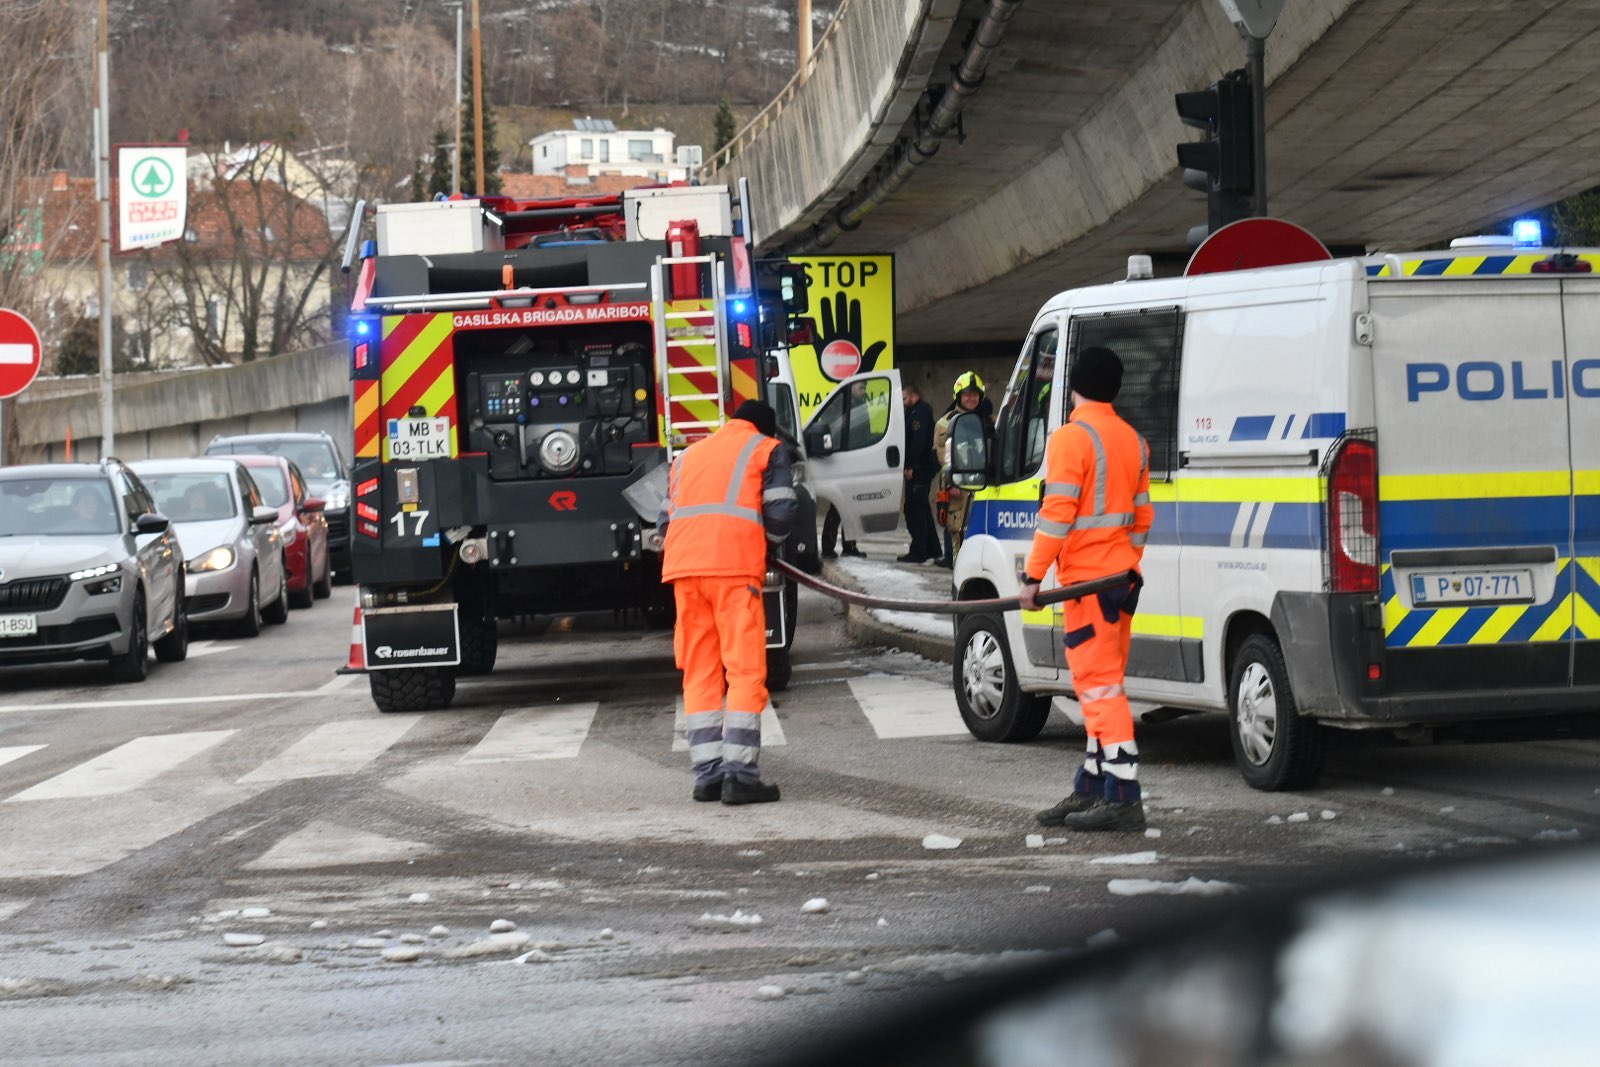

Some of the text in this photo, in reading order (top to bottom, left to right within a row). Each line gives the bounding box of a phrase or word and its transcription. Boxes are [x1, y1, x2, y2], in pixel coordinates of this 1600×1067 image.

[453, 305, 650, 327] GASILSKA BRIGADA MARIBOR
[409, 422, 430, 437] MB
[1195, 417, 1212, 430] 113
[393, 440, 445, 455] 03-TLK
[390, 510, 430, 537] 17
[1438, 575, 1520, 597] P 07-771
[0, 619, 33, 630] 1-BSU
[393, 646, 448, 658] rosenbauer
